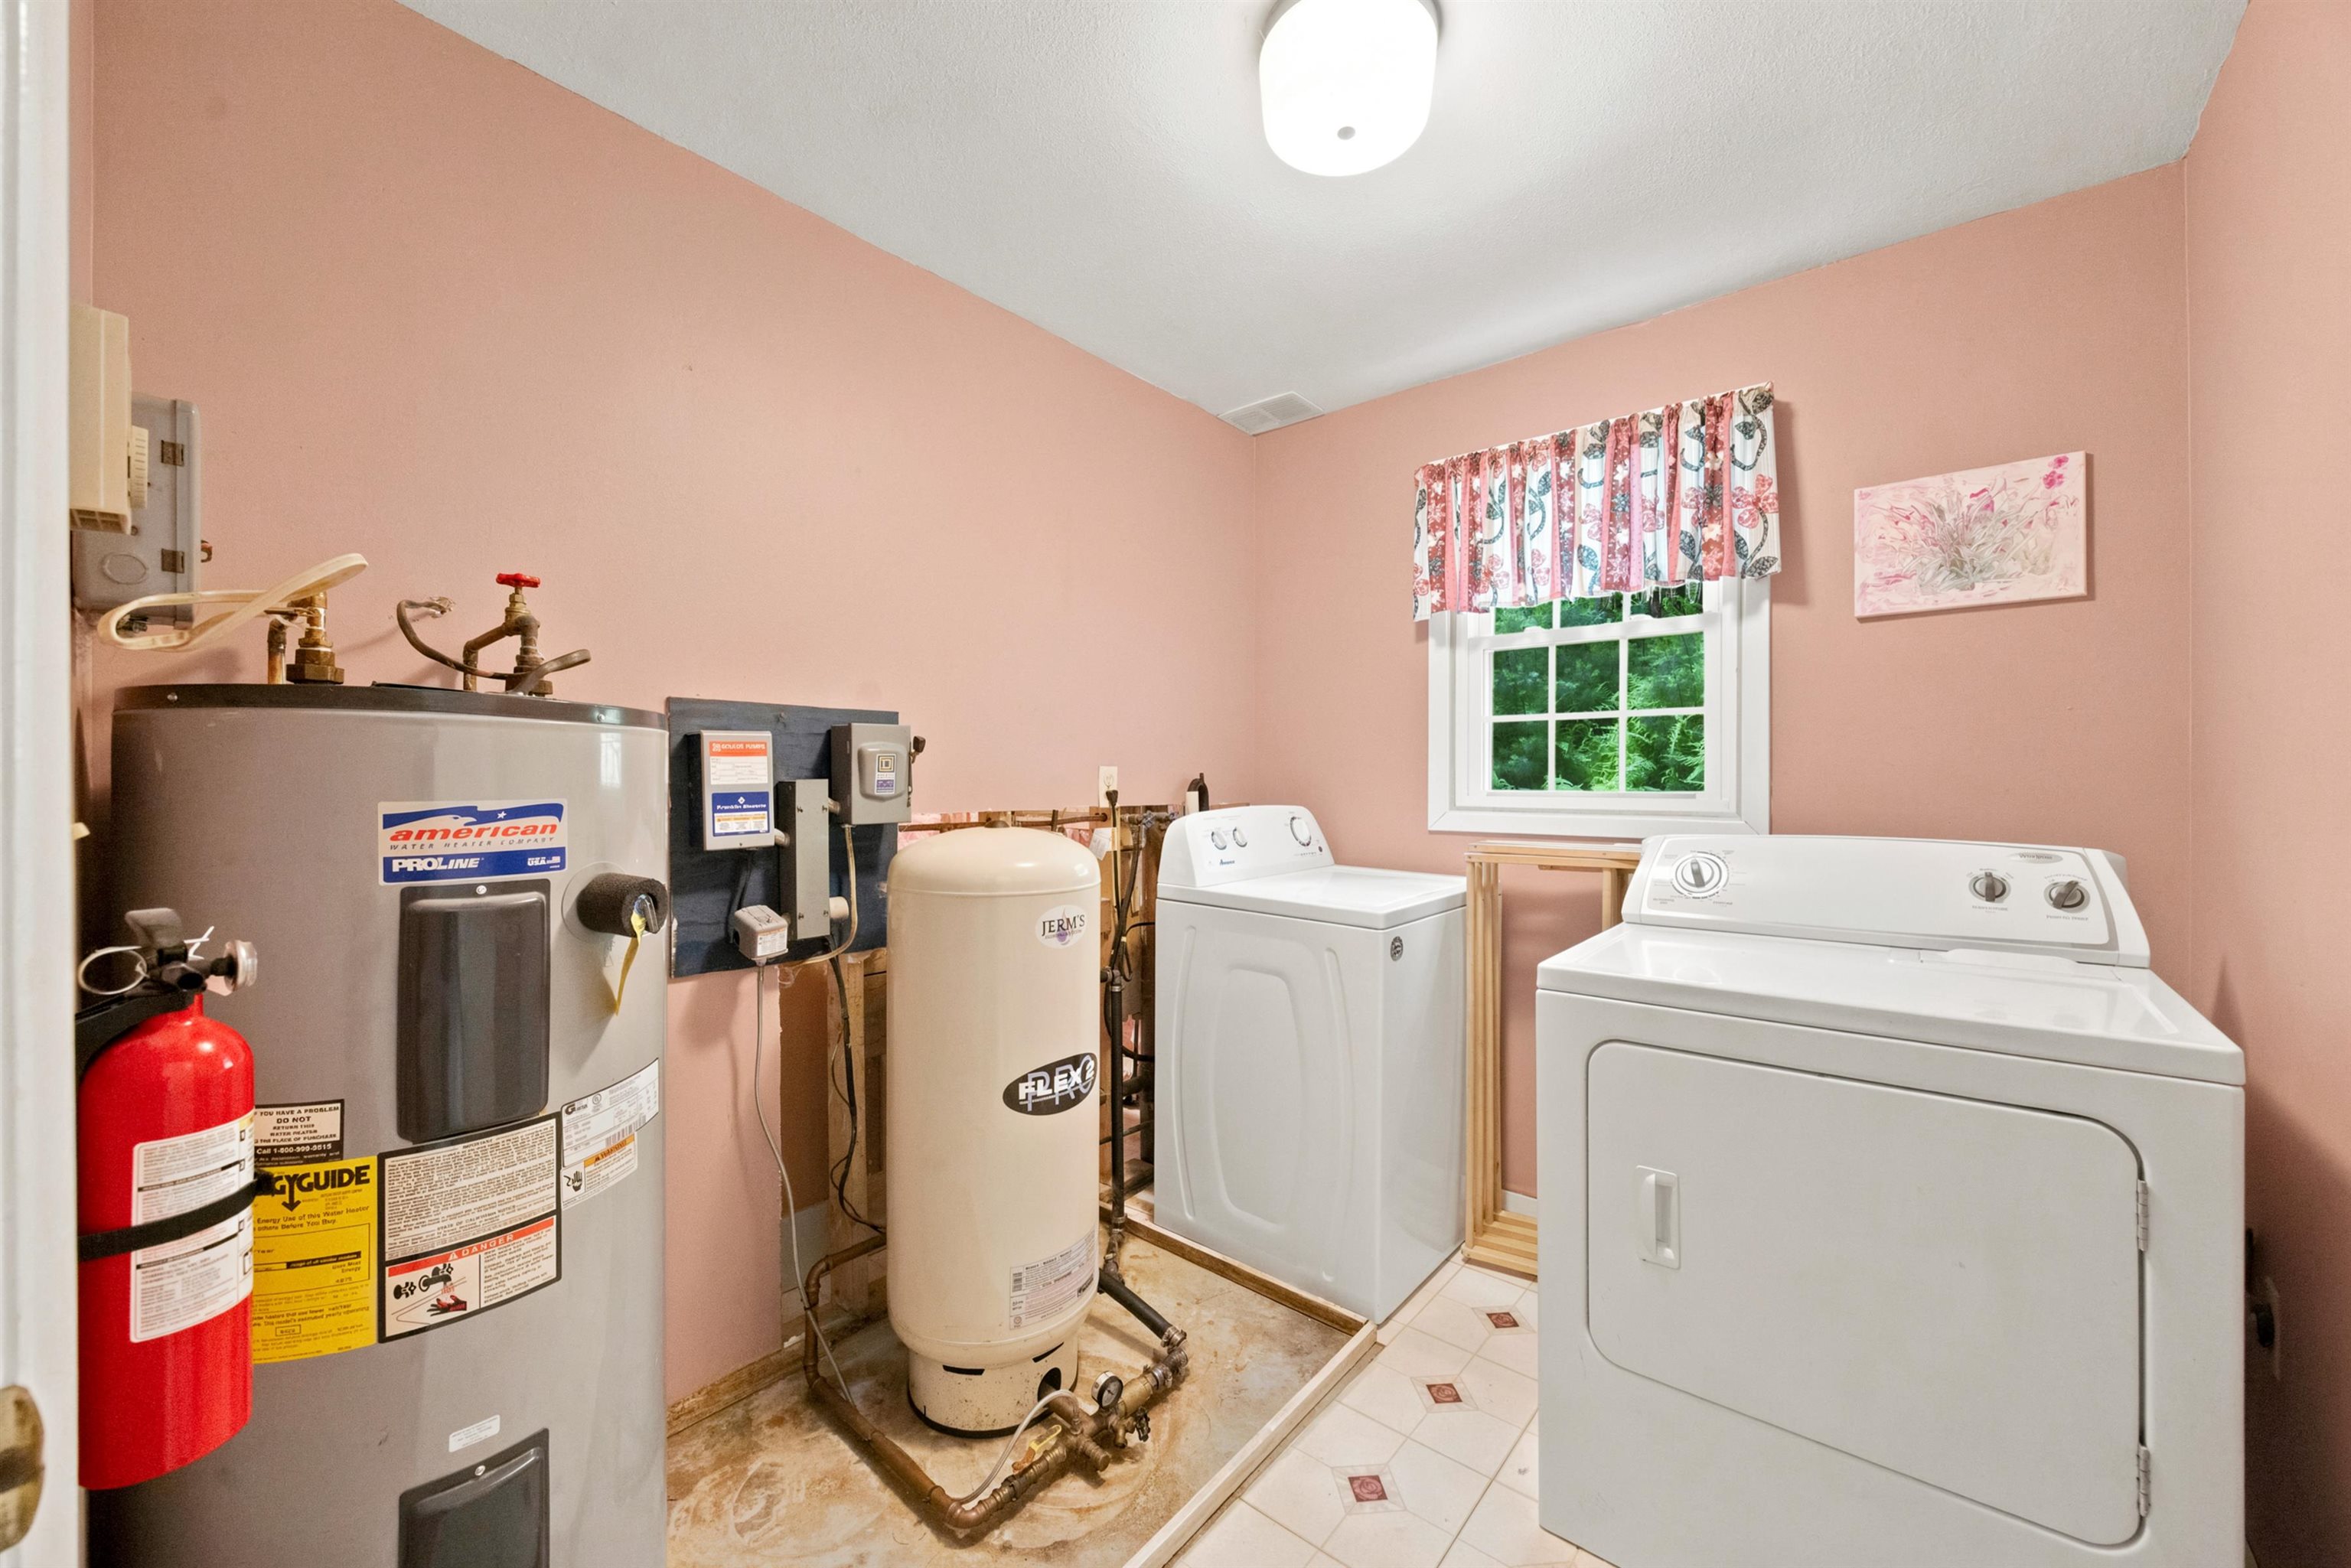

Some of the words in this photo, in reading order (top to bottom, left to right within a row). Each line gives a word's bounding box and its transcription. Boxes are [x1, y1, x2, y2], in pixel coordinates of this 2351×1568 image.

[389, 823, 558, 842] american
[501, 836, 555, 846] COMPANY
[1042, 914, 1085, 937] JERM'S
[461, 1234, 515, 1257] DANGER
